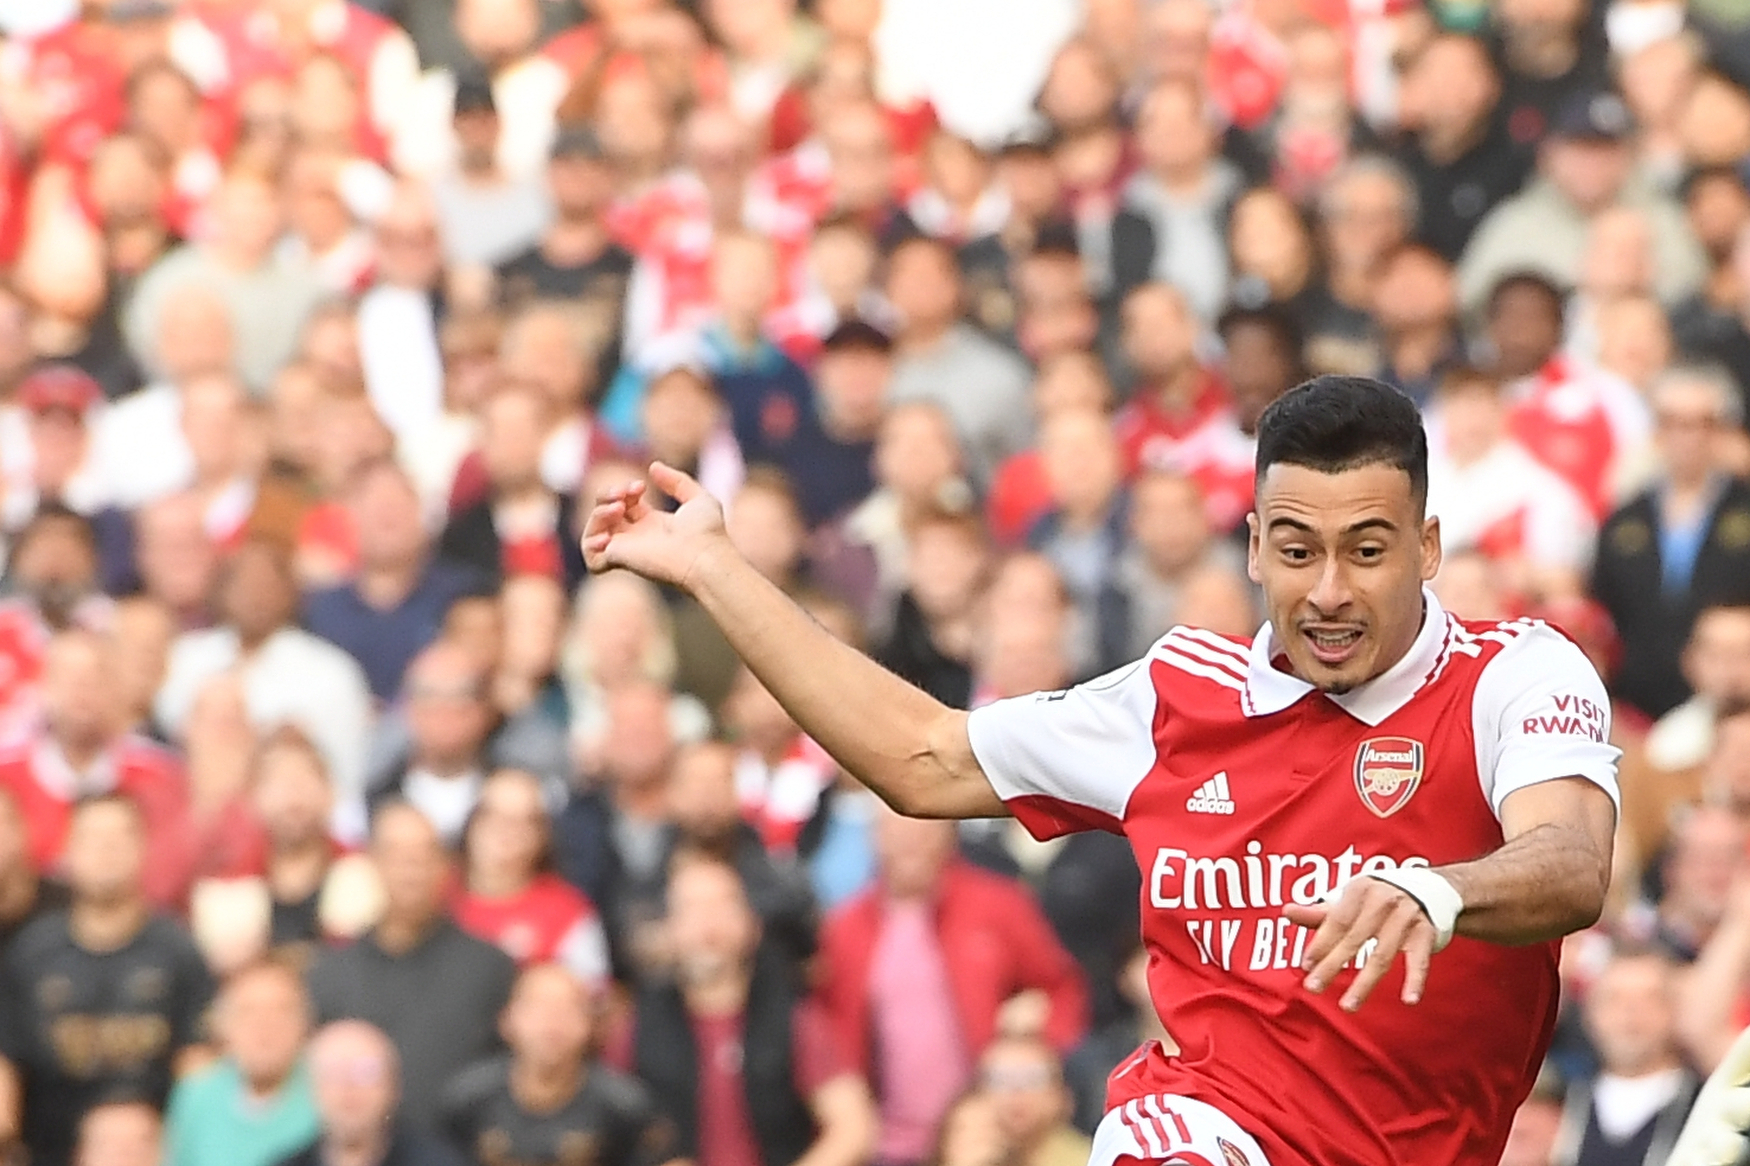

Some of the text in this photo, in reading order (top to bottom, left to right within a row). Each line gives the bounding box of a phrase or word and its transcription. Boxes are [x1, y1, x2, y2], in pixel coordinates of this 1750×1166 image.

[1551, 694, 1606, 730] VISIT
[1365, 749, 1413, 763] Arsenal
[1186, 797, 1235, 815] adidas
